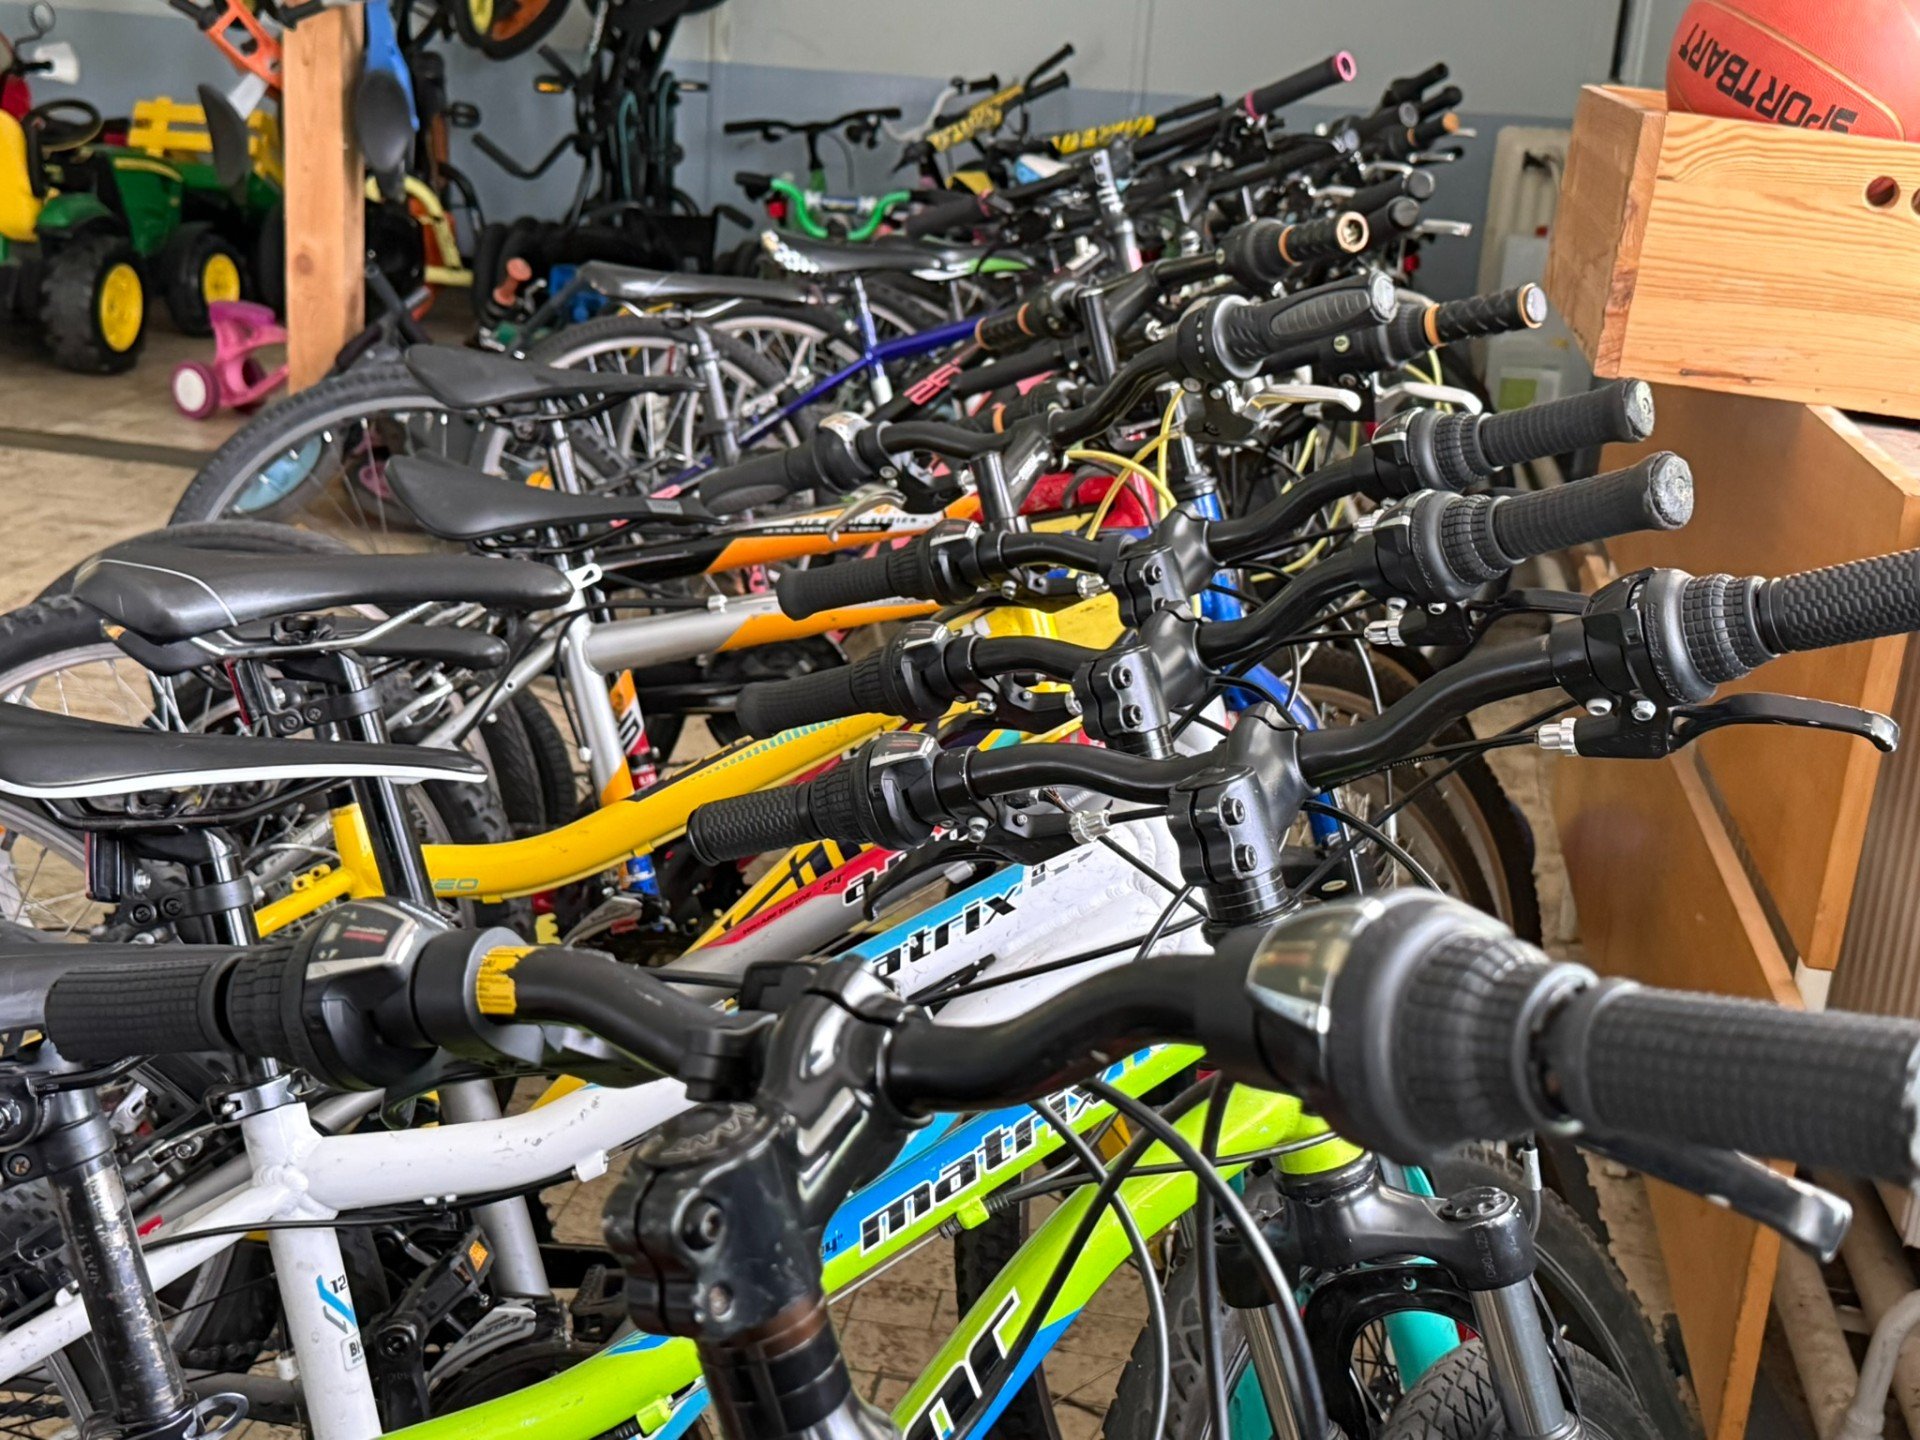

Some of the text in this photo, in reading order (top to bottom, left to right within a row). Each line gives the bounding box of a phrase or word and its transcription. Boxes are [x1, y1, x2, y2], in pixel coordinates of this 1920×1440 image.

[1679, 23, 1858, 134] SPORTBART
[872, 886, 1018, 977] atrix
[860, 1072, 1108, 1256] matrix
